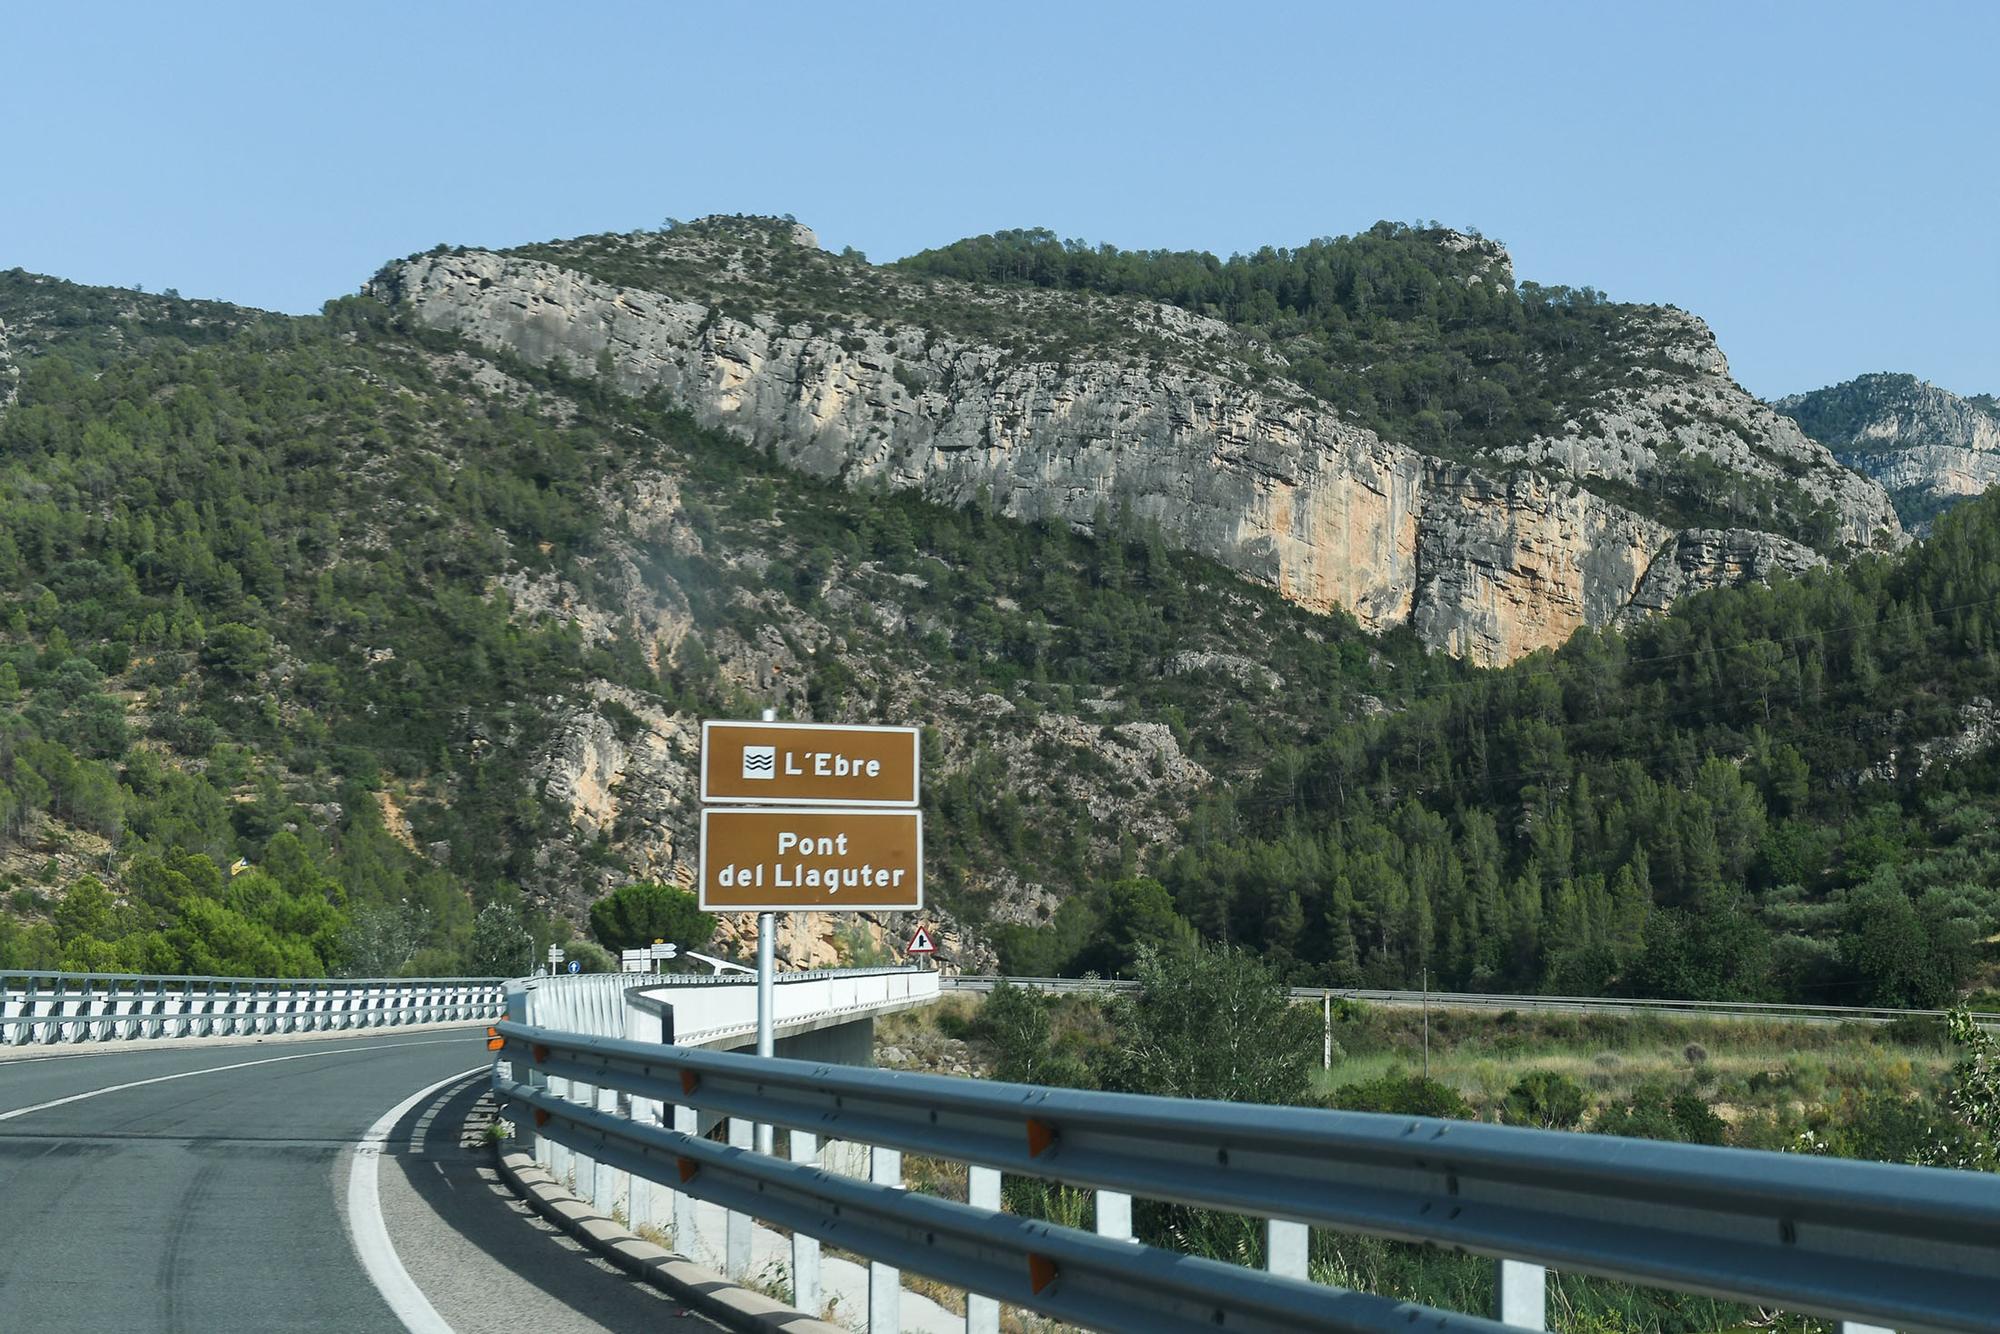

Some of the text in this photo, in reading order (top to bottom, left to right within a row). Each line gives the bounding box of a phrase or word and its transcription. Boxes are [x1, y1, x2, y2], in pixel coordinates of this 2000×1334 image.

[778, 832, 848, 855] Pont
[718, 864, 905, 894] del Llaguter
